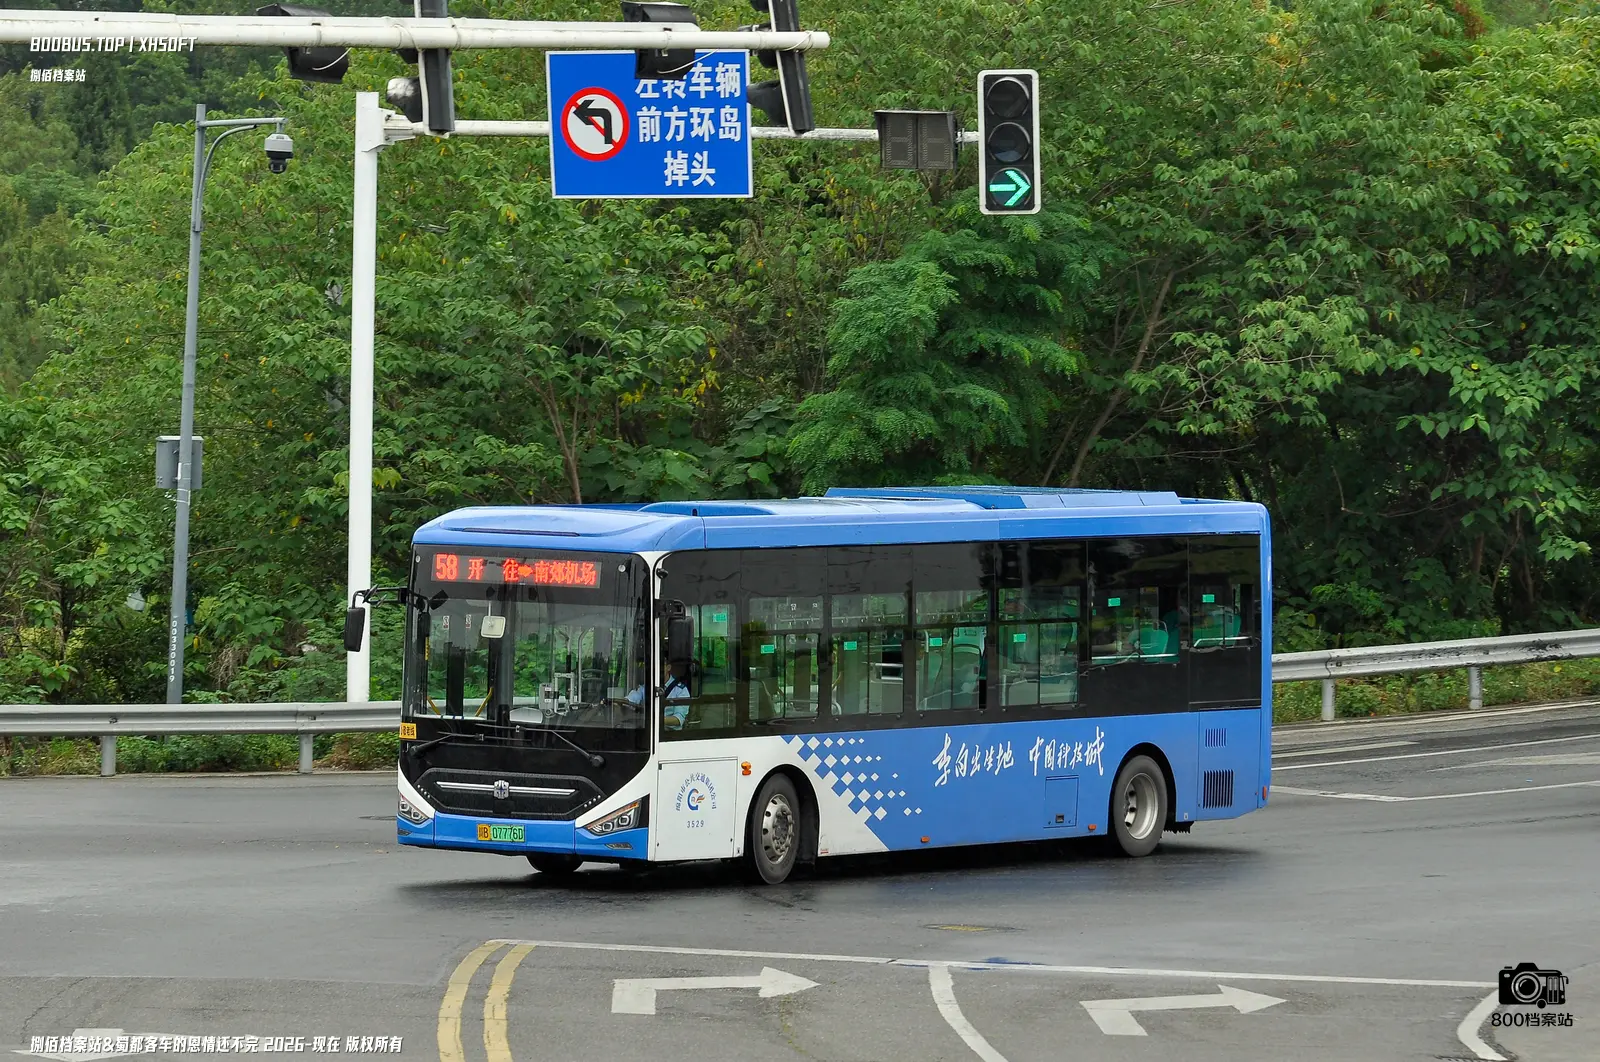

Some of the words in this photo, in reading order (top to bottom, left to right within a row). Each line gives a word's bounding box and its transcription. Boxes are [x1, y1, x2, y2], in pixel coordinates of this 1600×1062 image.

[636, 105, 741, 143] 前方环岛
[664, 150, 716, 187] 掉头
[435, 553, 459, 580] 58
[467, 558, 484, 580] 开
[503, 558, 520, 582] 往
[534, 560, 597, 585] 南郊机场
[169, 620, 178, 682] 00330019
[932, 732, 1015, 788] 李白出生地
[1028, 725, 1105, 777] 中国科技城
[686, 819, 705, 828] 3529
